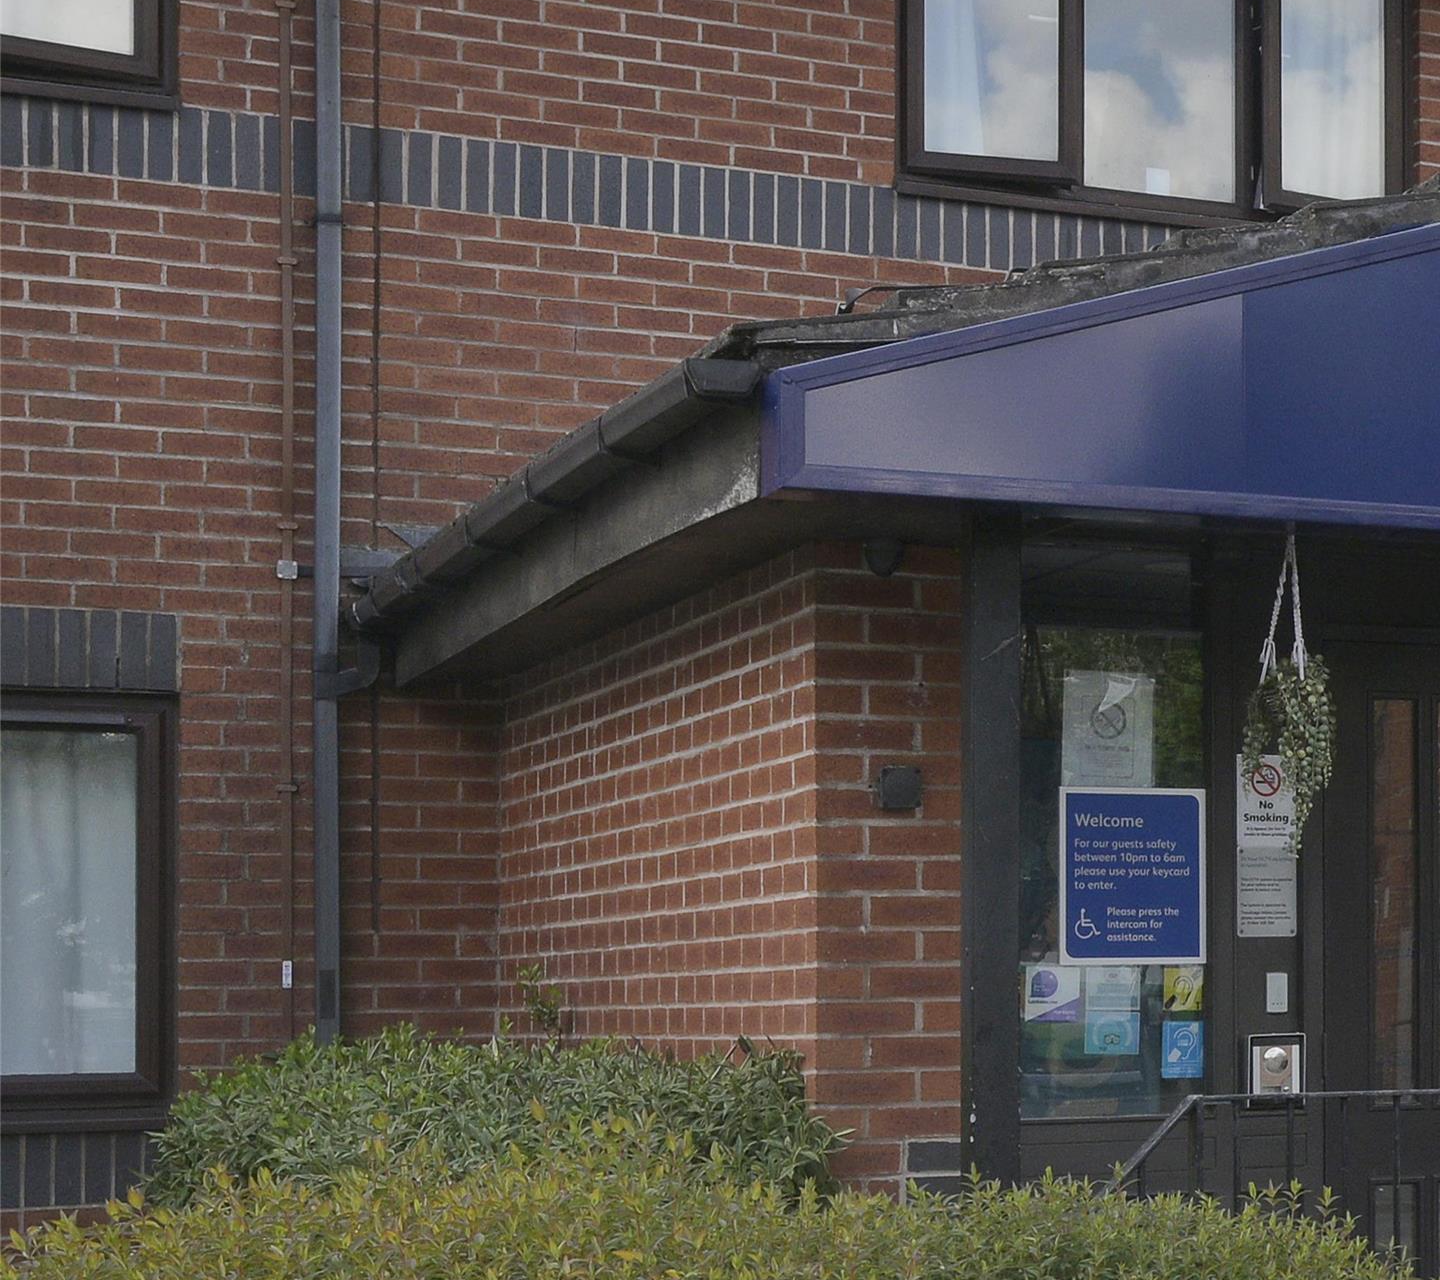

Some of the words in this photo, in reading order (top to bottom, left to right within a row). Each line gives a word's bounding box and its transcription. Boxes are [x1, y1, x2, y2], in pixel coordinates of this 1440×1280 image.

[1258, 800, 1274, 809] No
[1074, 813, 1144, 828] Welcome
[1243, 812, 1289, 825] Smoking
[1074, 838, 1090, 848] For
[1092, 839, 1109, 848] our
[1111, 839, 1144, 851] guests
[1146, 839, 1177, 851] safety
[1074, 852, 1117, 862] between
[1120, 852, 1148, 865] 10pm
[1150, 853, 1161, 863] to
[1163, 853, 1186, 863] 6am
[1074, 866, 1106, 878] please
[1109, 868, 1126, 876] use
[1128, 867, 1150, 878] your
[1152, 867, 1190, 879] keycard
[1074, 881, 1086, 890] to
[1087, 881, 1117, 890] enter.
[1106, 907, 1137, 917] Please
[1138, 908, 1162, 918] press
[1163, 907, 1179, 917] the
[1106, 920, 1148, 929] intercom
[1149, 920, 1163, 929] for
[1106, 932, 1156, 942] assistance.
